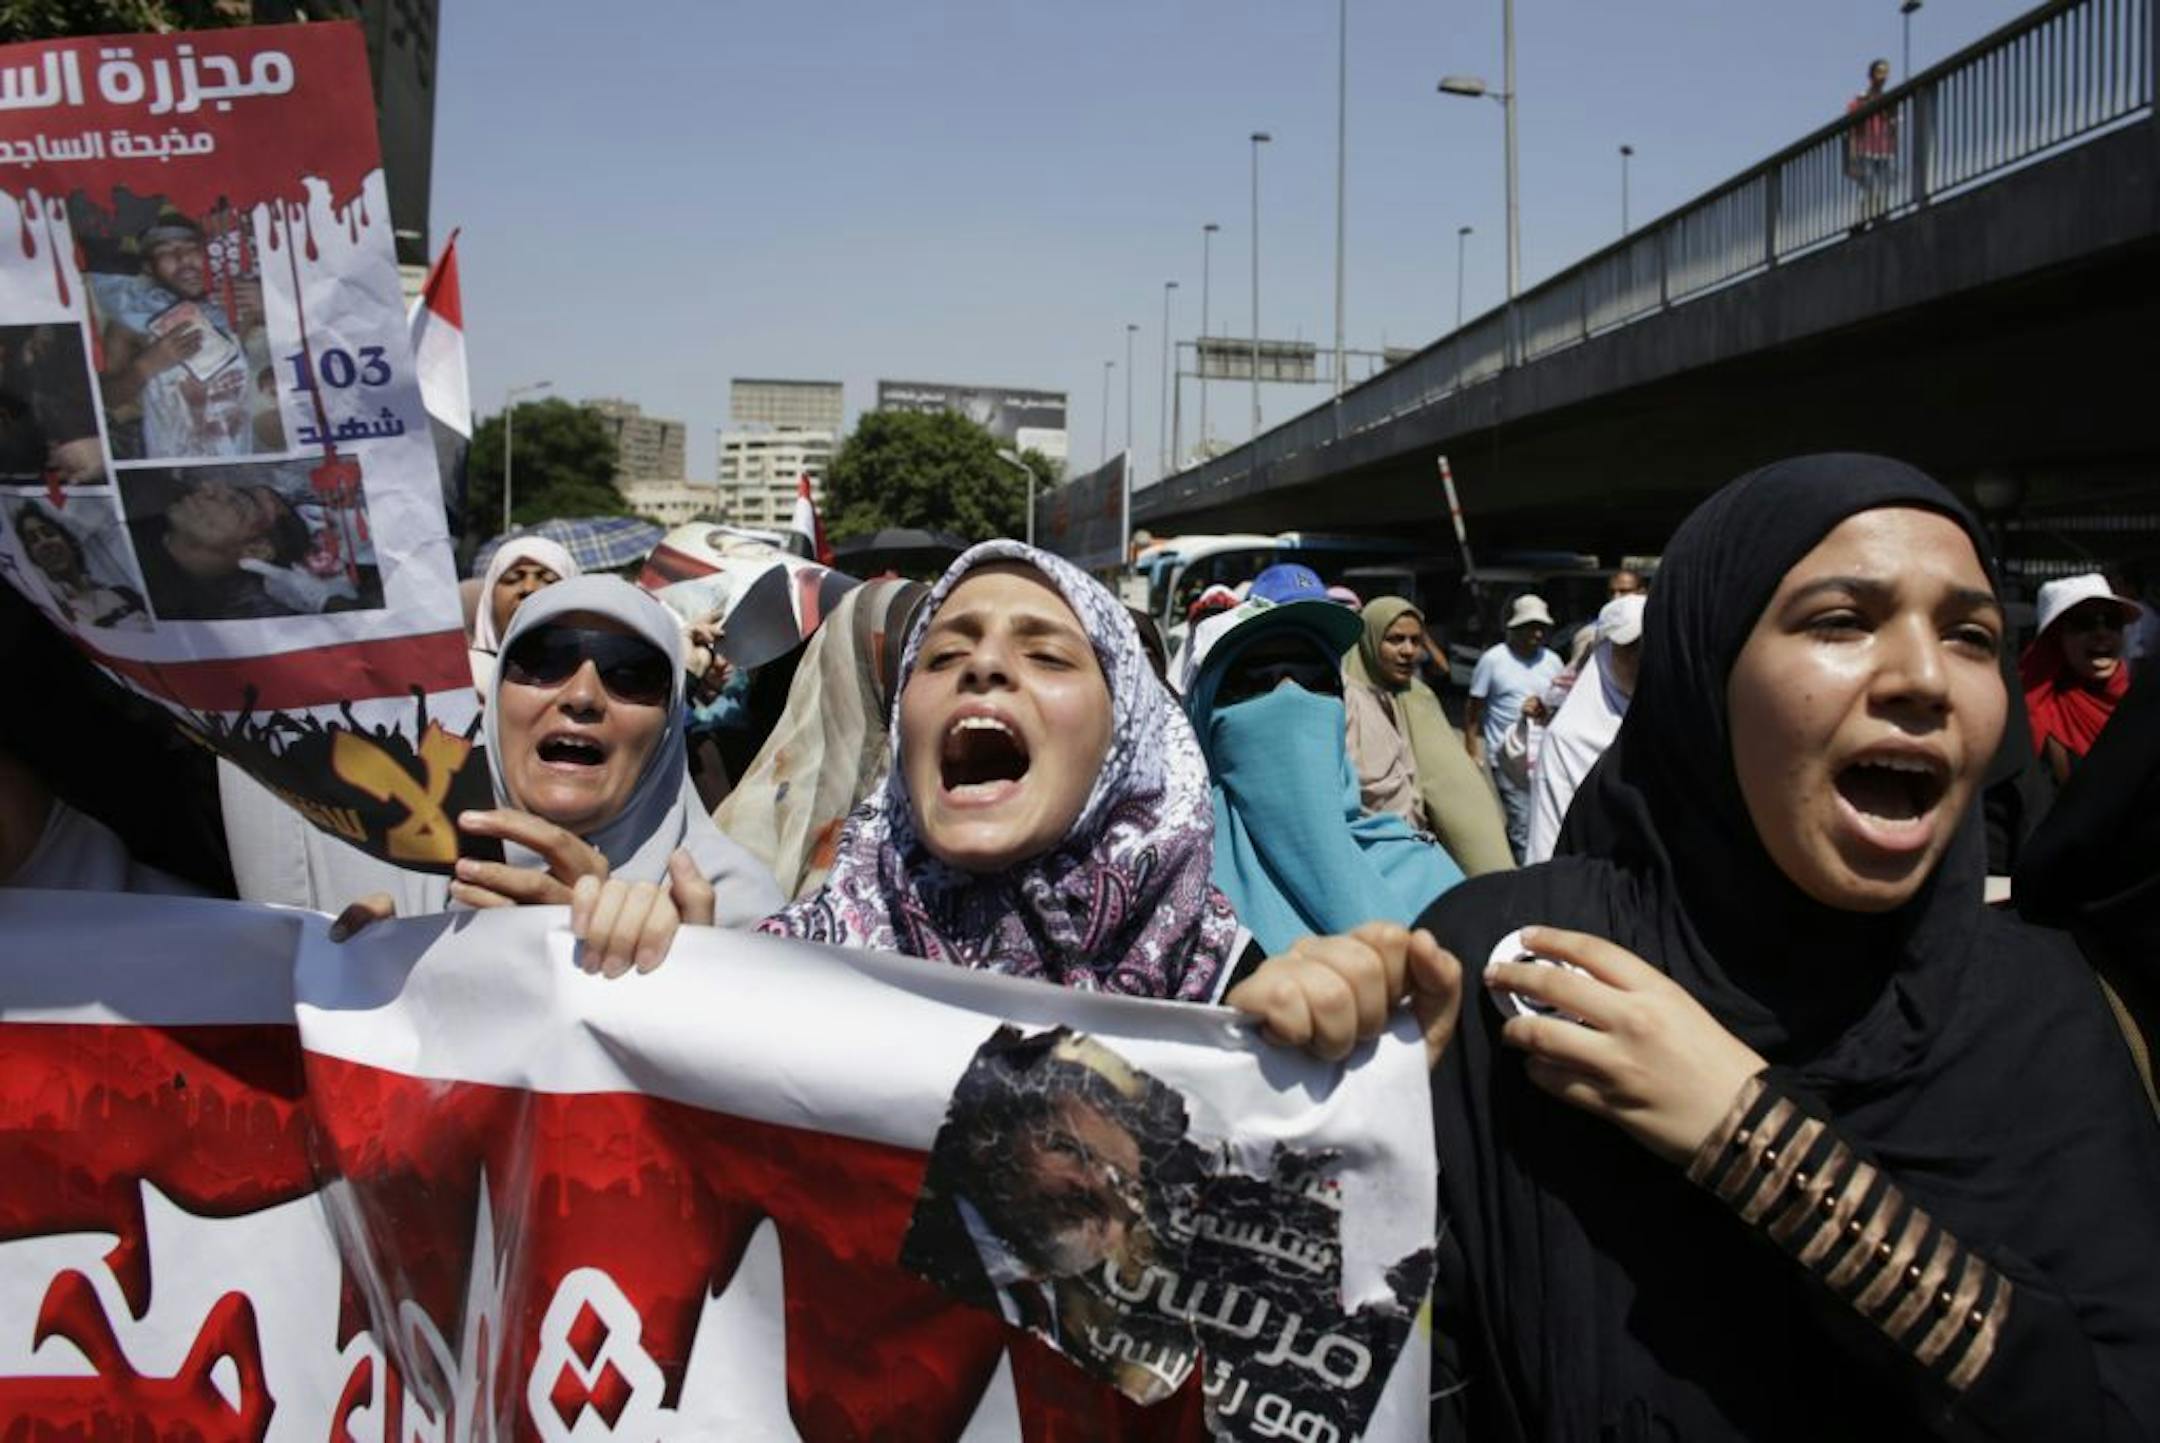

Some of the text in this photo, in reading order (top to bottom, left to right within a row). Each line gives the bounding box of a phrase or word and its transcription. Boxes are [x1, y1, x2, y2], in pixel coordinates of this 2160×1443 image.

[98, 44, 295, 115] مجزرة
[109, 127, 215, 162] مذبحة
[285, 345, 393, 392] 103
[1103, 1257, 1373, 1391] مرسي
